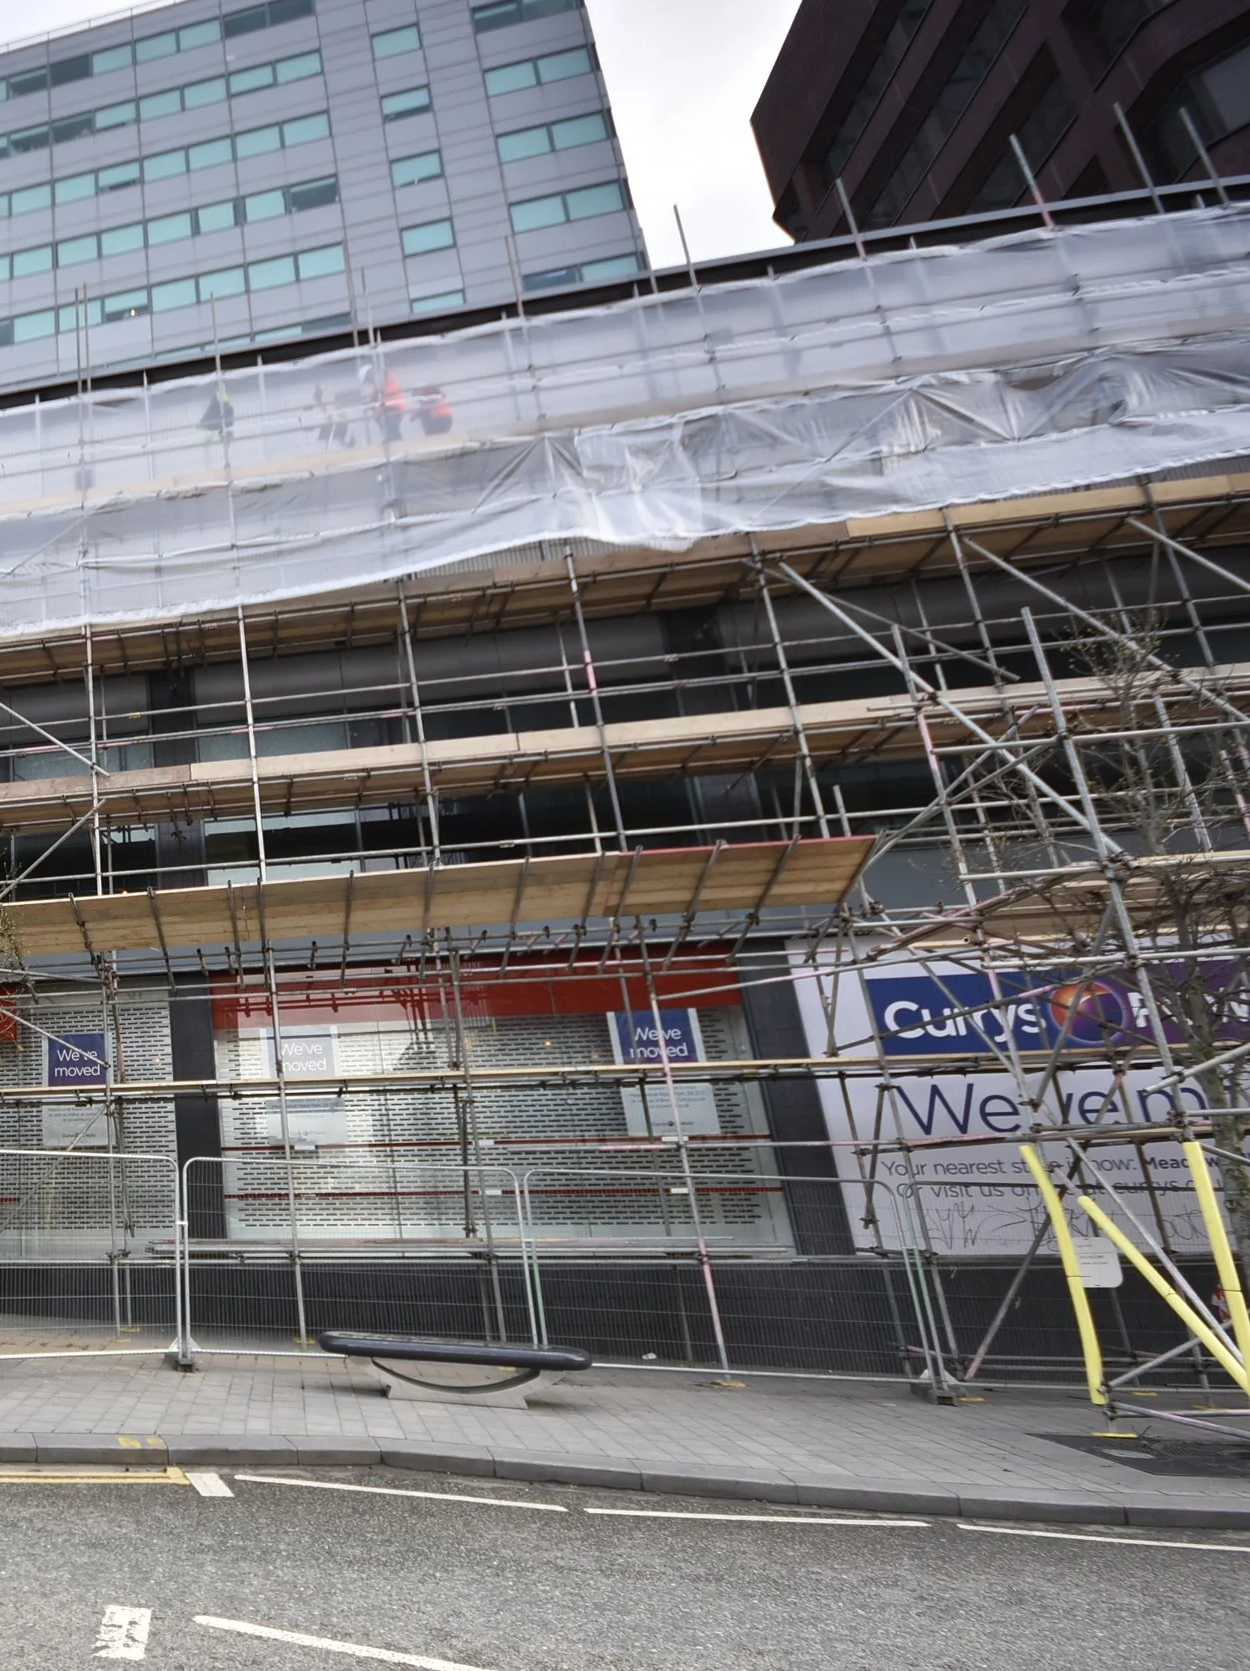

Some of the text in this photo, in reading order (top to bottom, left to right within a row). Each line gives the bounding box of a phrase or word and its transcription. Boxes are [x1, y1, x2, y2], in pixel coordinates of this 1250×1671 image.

[883, 999, 1048, 1043] Currys
[634, 1026, 682, 1041] Weve
[280, 1042, 324, 1056] We've
[54, 1063, 101, 1077] moved
[281, 1056, 328, 1073] moved
[897, 1081, 1120, 1136] Weve
[881, 1160, 928, 1177] Your
[933, 1159, 1007, 1176] nearest
[1012, 1157, 1062, 1174] ste
[930, 1183, 974, 1199] visit
[979, 1185, 1005, 1198] us
